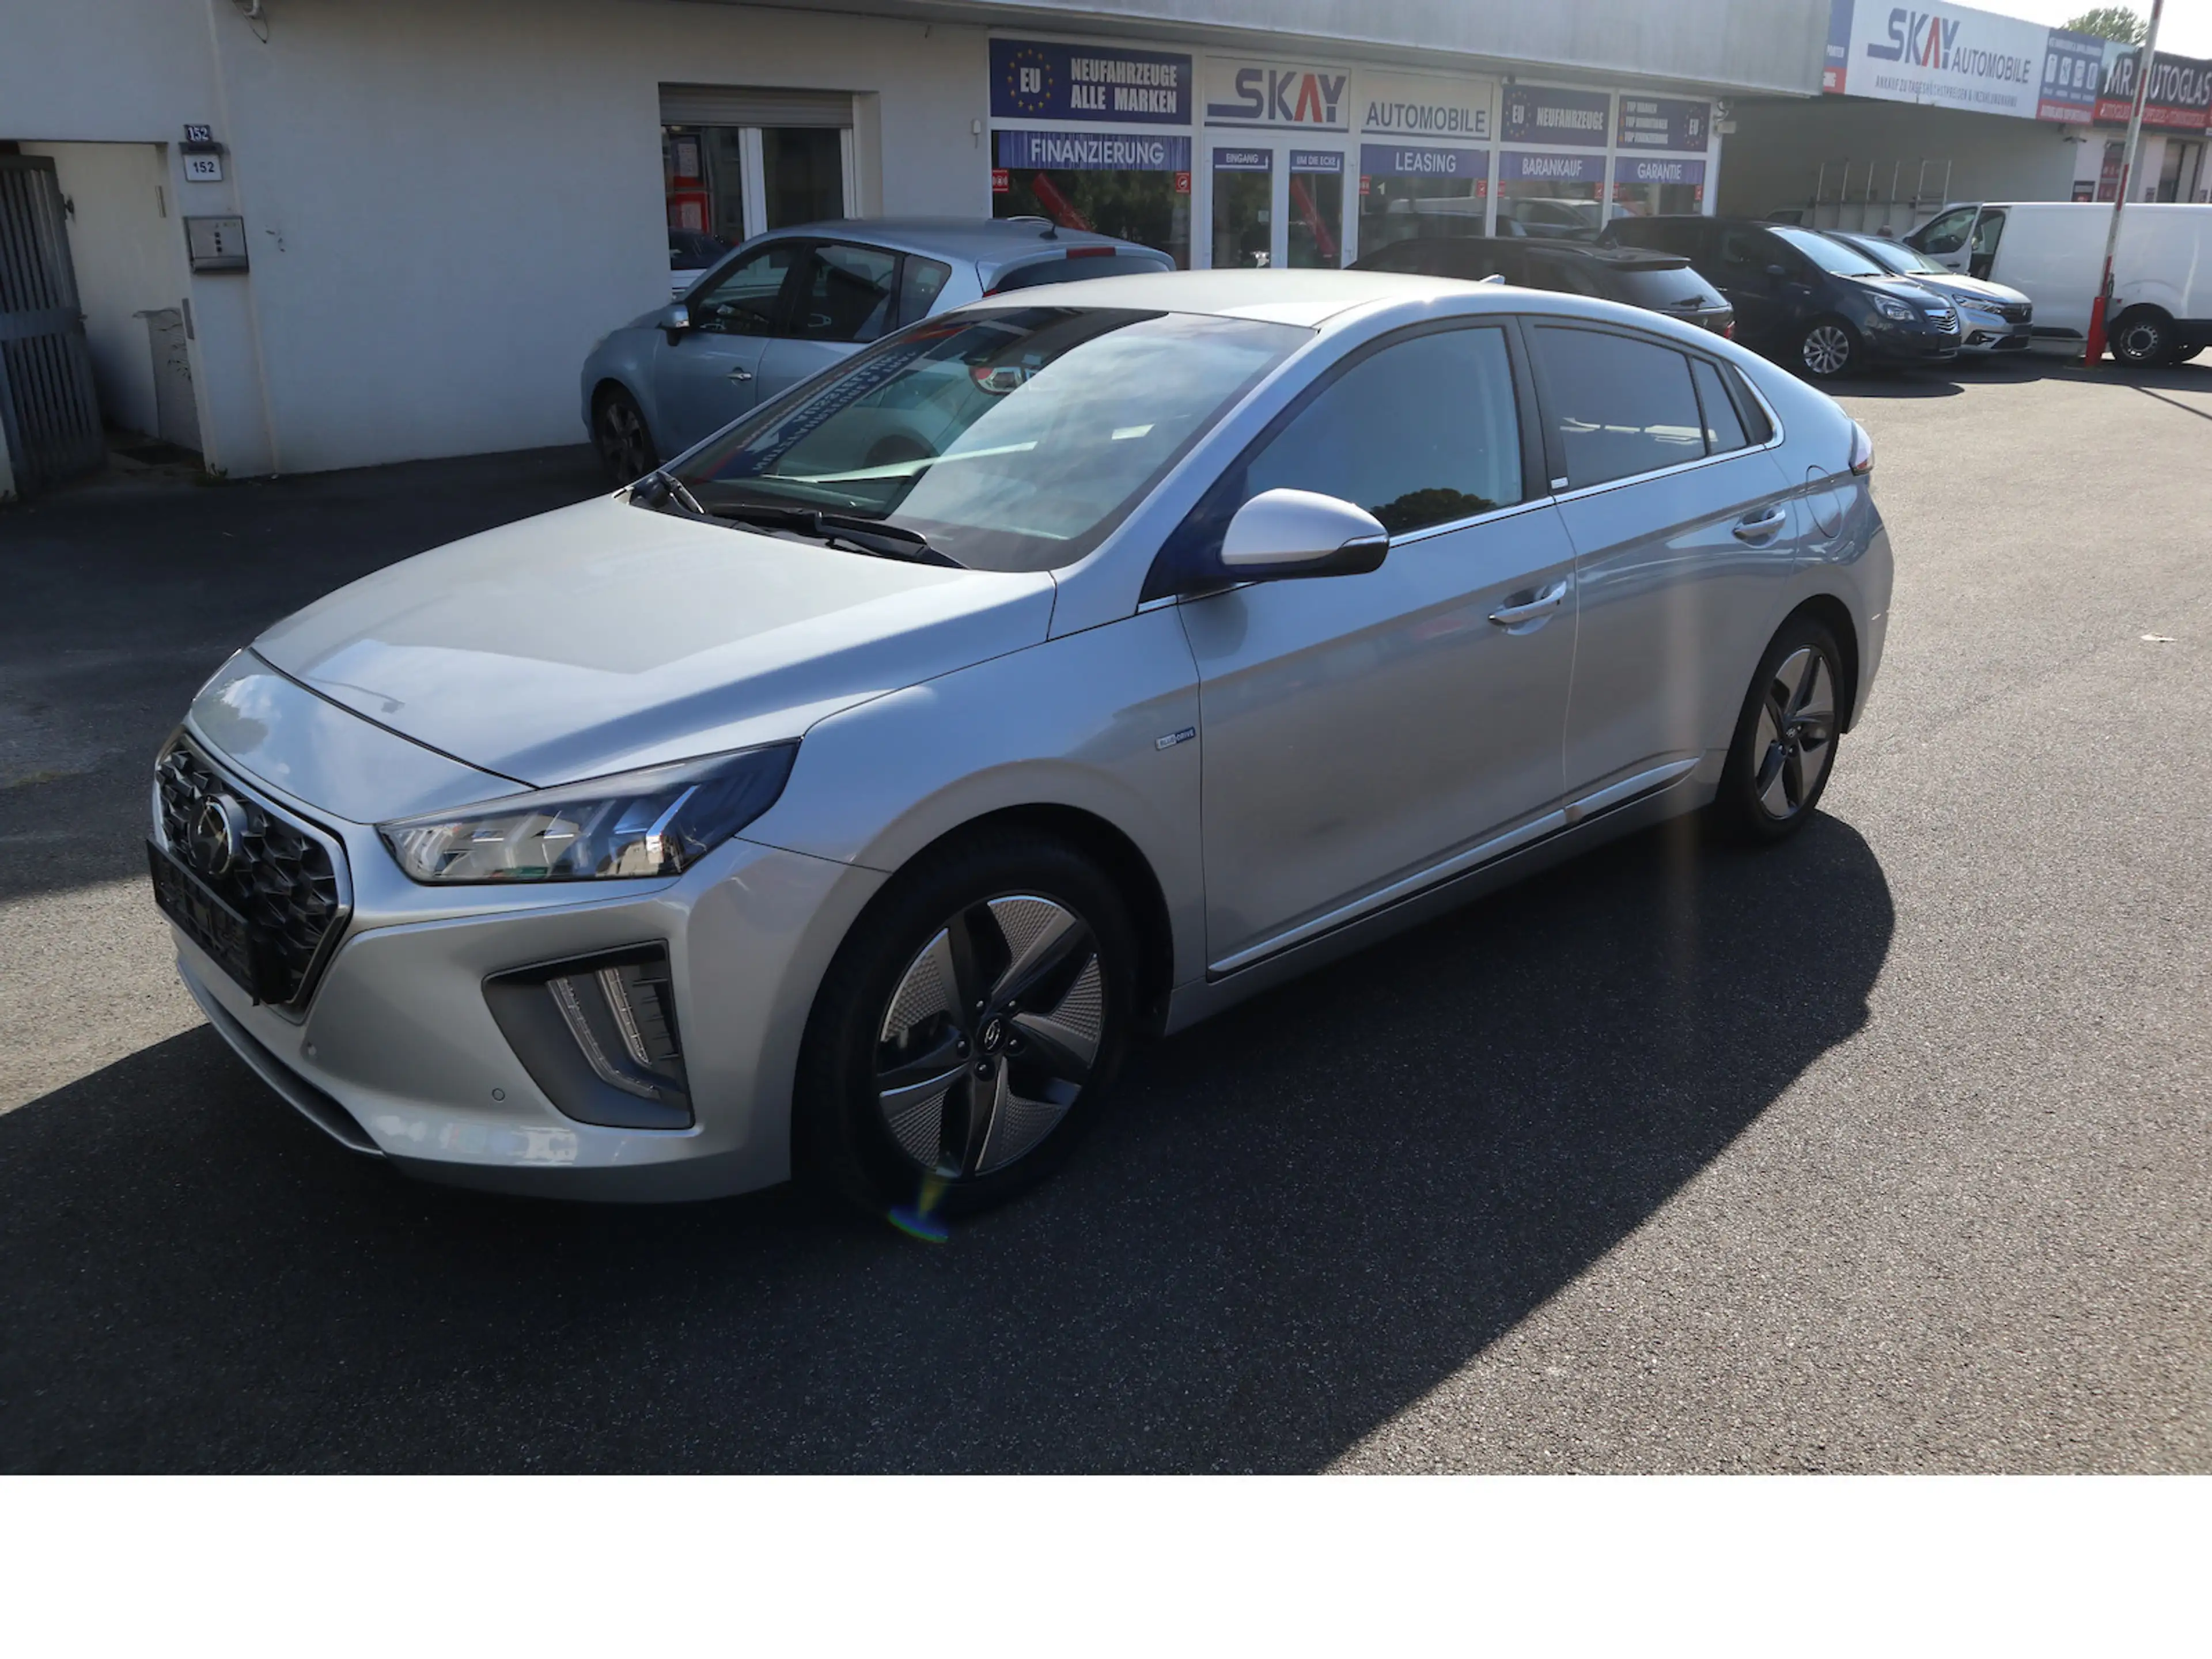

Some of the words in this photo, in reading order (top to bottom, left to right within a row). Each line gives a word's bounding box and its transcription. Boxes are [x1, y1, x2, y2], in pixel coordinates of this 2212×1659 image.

[1867, 7, 1960, 70] SKAY
[1071, 58, 1177, 88] NEUFAHRZEUGE
[1952, 47, 2031, 84] AUTOMOBILE
[1020, 67, 1041, 93] EU
[2103, 58, 2134, 96] MR.
[2149, 62, 2212, 106] UTOGLAS
[1070, 85, 1105, 111] ALLE
[1115, 88, 1177, 113] MARKEN
[1207, 67, 1347, 123] SKAY
[1366, 101, 1486, 133] AUTOMOBILE
[1512, 104, 1524, 124] EU
[1536, 106, 1604, 131] NEUFAHRZEUGE
[1689, 119, 1699, 135] EU
[188, 127, 209, 142] 152
[1031, 138, 1165, 165] FINANZIERUNG
[1226, 153, 1259, 164] EINGANG
[1297, 155, 1307, 165] UM
[1308, 156, 1319, 165] DIE
[1395, 151, 1456, 173] LEASING
[194, 161, 215, 173] 152
[1522, 157, 1583, 177] BARANKAUF
[1638, 163, 1682, 180] GARANTIE
